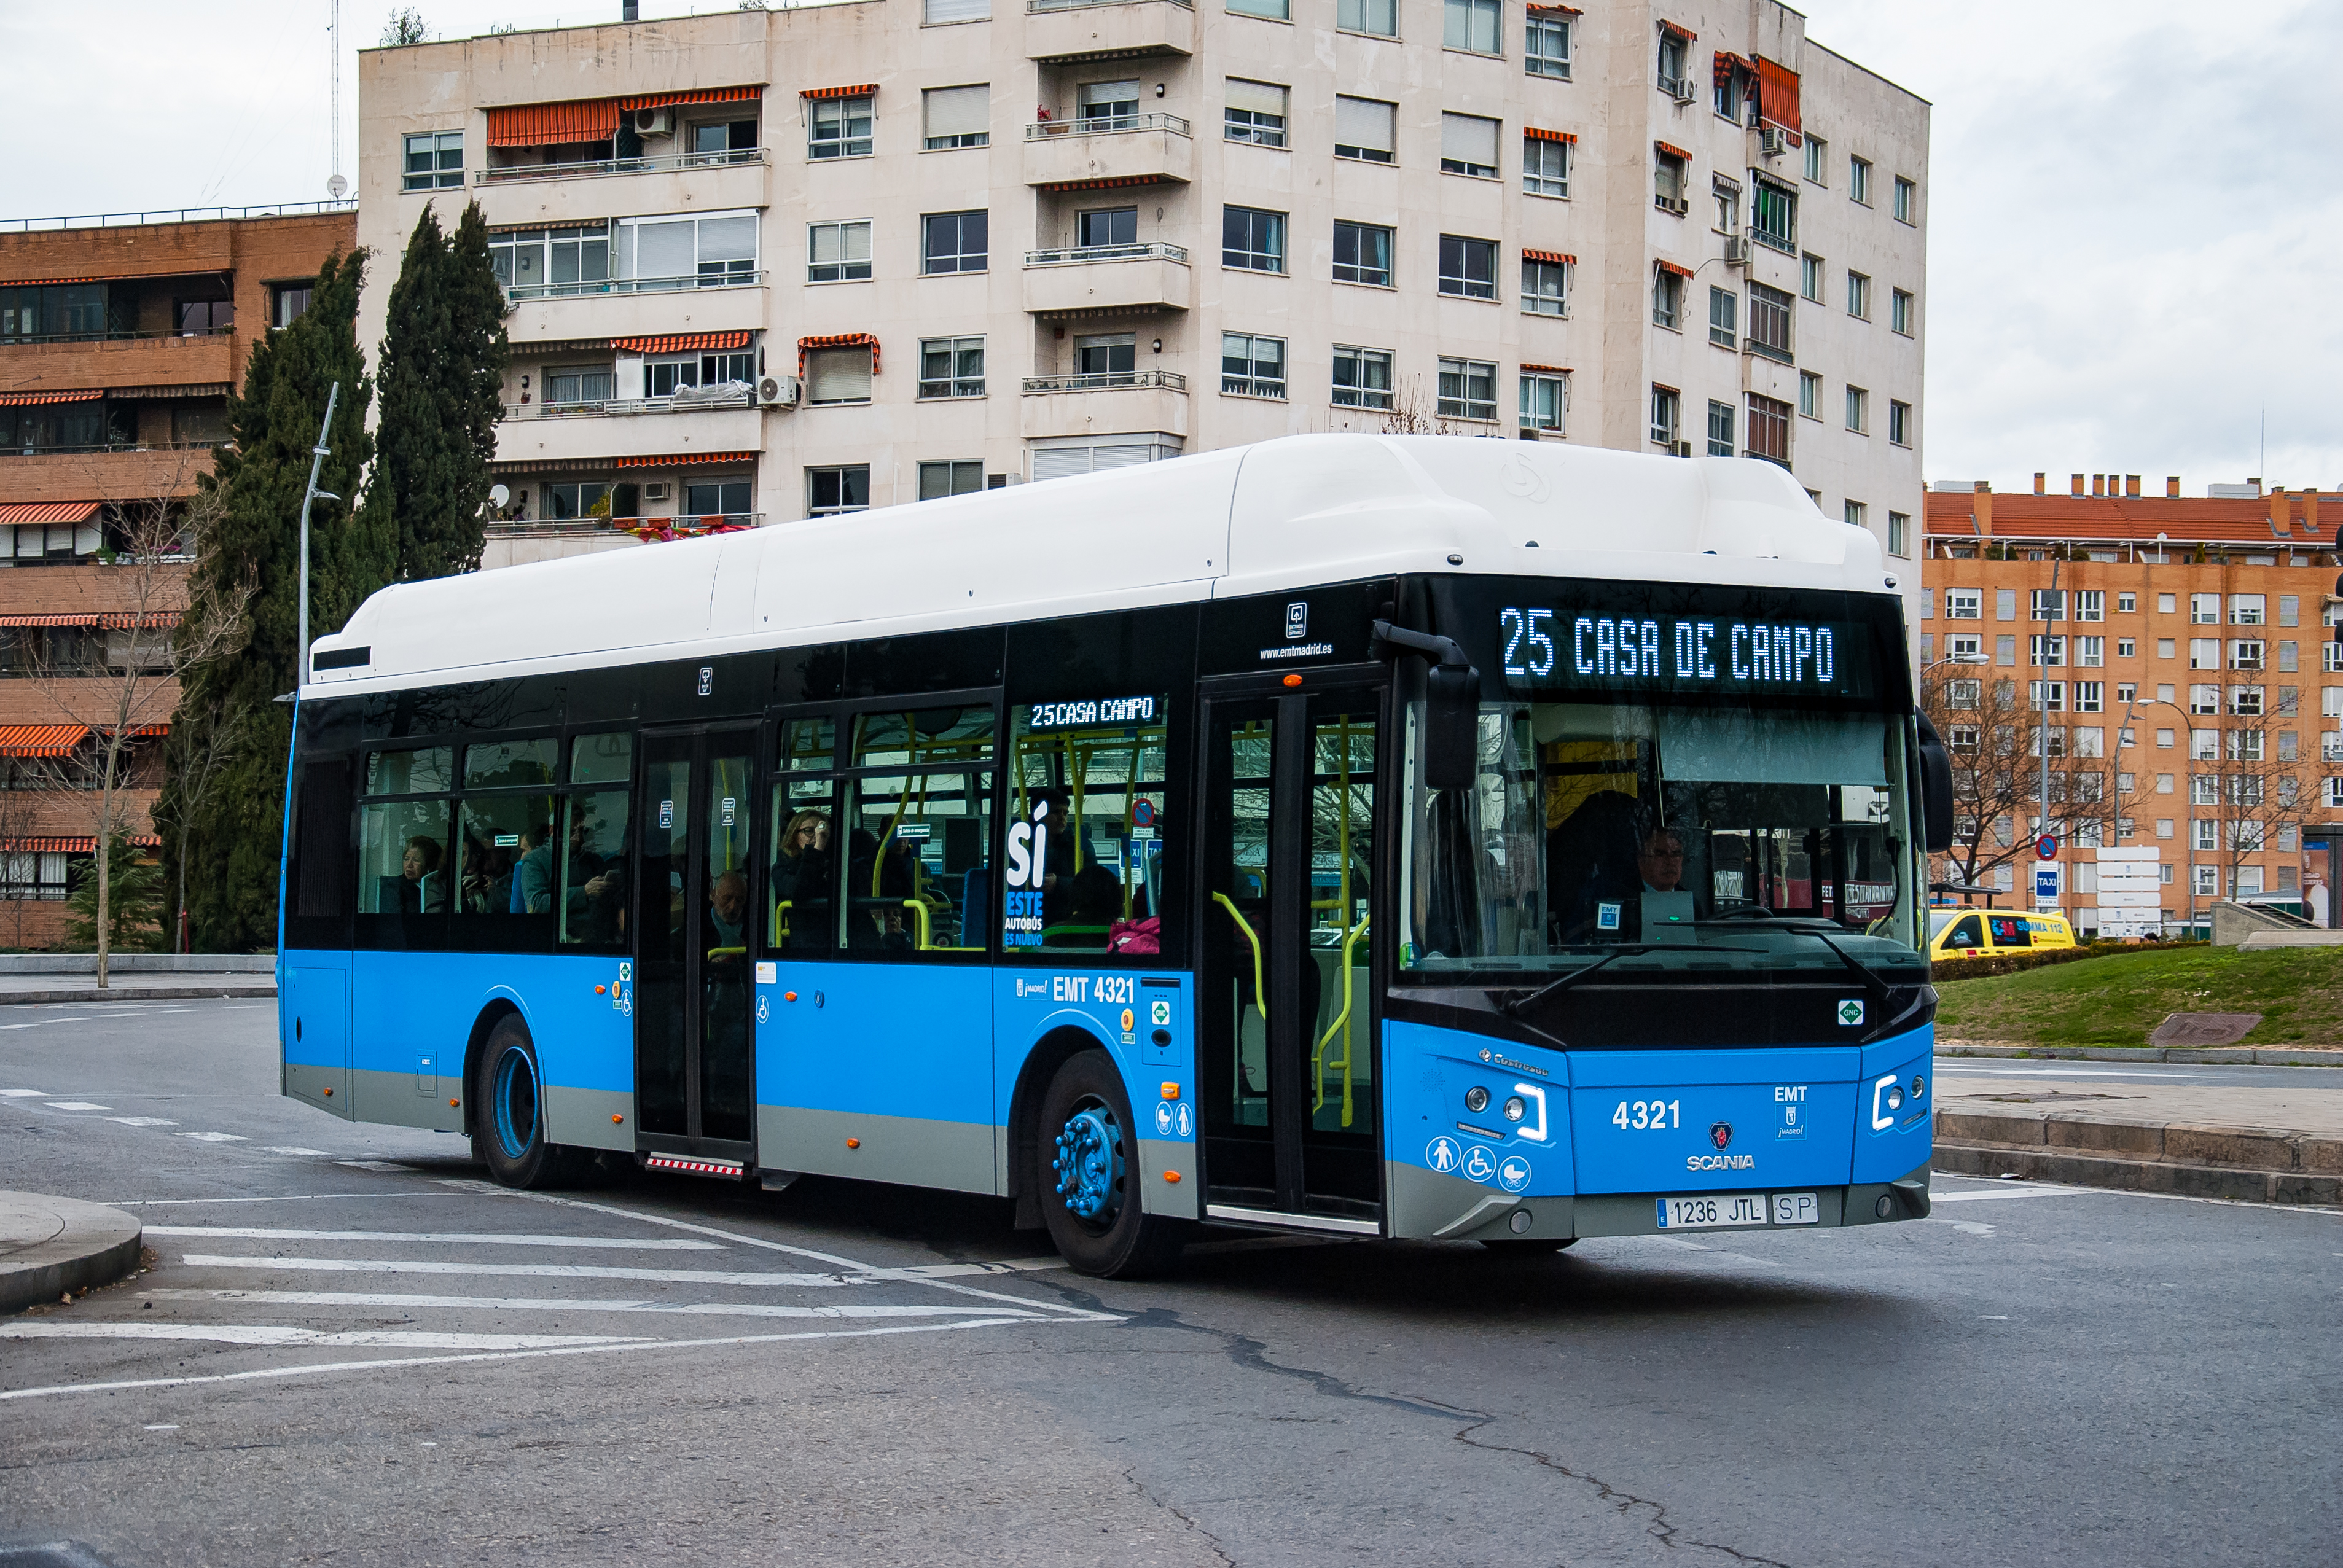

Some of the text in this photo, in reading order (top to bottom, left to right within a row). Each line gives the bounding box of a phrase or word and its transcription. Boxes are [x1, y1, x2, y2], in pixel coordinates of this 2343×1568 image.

[1260, 642, 1332, 659] www.emtmadrid.es
[1501, 608, 1833, 682] 25 CASA DE CAMPO
[1100, 697, 1153, 721] CAMPO
[1006, 800, 1048, 888] SÍ
[2038, 878, 2056, 886] TAXI
[1006, 892, 1043, 916] ESTE
[1004, 915, 1042, 930] AUTOBÚS
[2016, 921, 2063, 933] SUMMA 112
[1004, 933, 1043, 946] ES NUEVO
[1053, 977, 1134, 1004] EMT 4321
[1775, 1086, 1807, 1102] EMT
[1612, 1099, 1680, 1130] 4321
[1686, 1155, 1756, 1172] SCANIA
[1674, 1198, 1761, 1224] 1236 JTL
